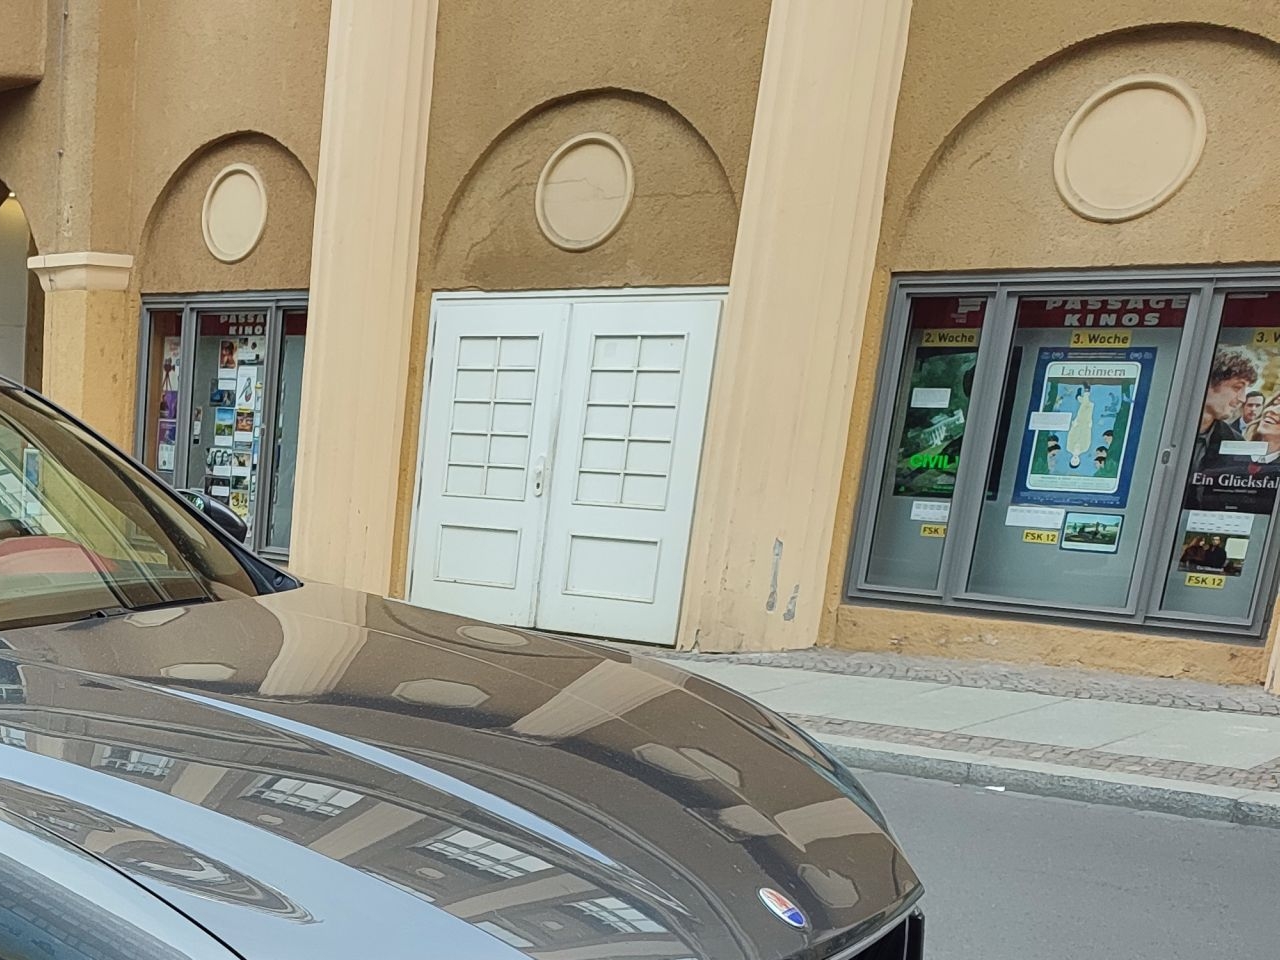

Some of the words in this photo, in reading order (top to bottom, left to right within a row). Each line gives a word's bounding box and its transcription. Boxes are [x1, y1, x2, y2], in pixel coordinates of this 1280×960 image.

[1046, 296, 1187, 310] PASSAGE
[220, 312, 265, 323] PASSA
[1064, 313, 1160, 326] KINOS
[229, 326, 266, 335] KINO
[924, 333, 935, 343] 2.
[938, 333, 975, 343] Woche
[1073, 333, 1084, 344] 3.
[1088, 333, 1129, 344] Woche
[1256, 332, 1268, 343] 3.
[1060, 366, 1075, 376] La
[1078, 366, 1126, 376] chimera
[910, 454, 950, 469] CIVIL
[1192, 472, 1214, 486] Ein
[1218, 473, 1280, 489] Glücksfal
[923, 526, 940, 535] FSK
[1024, 533, 1043, 541] FSK
[1187, 576, 1209, 585] FSK
[1211, 577, 1223, 587] 12
